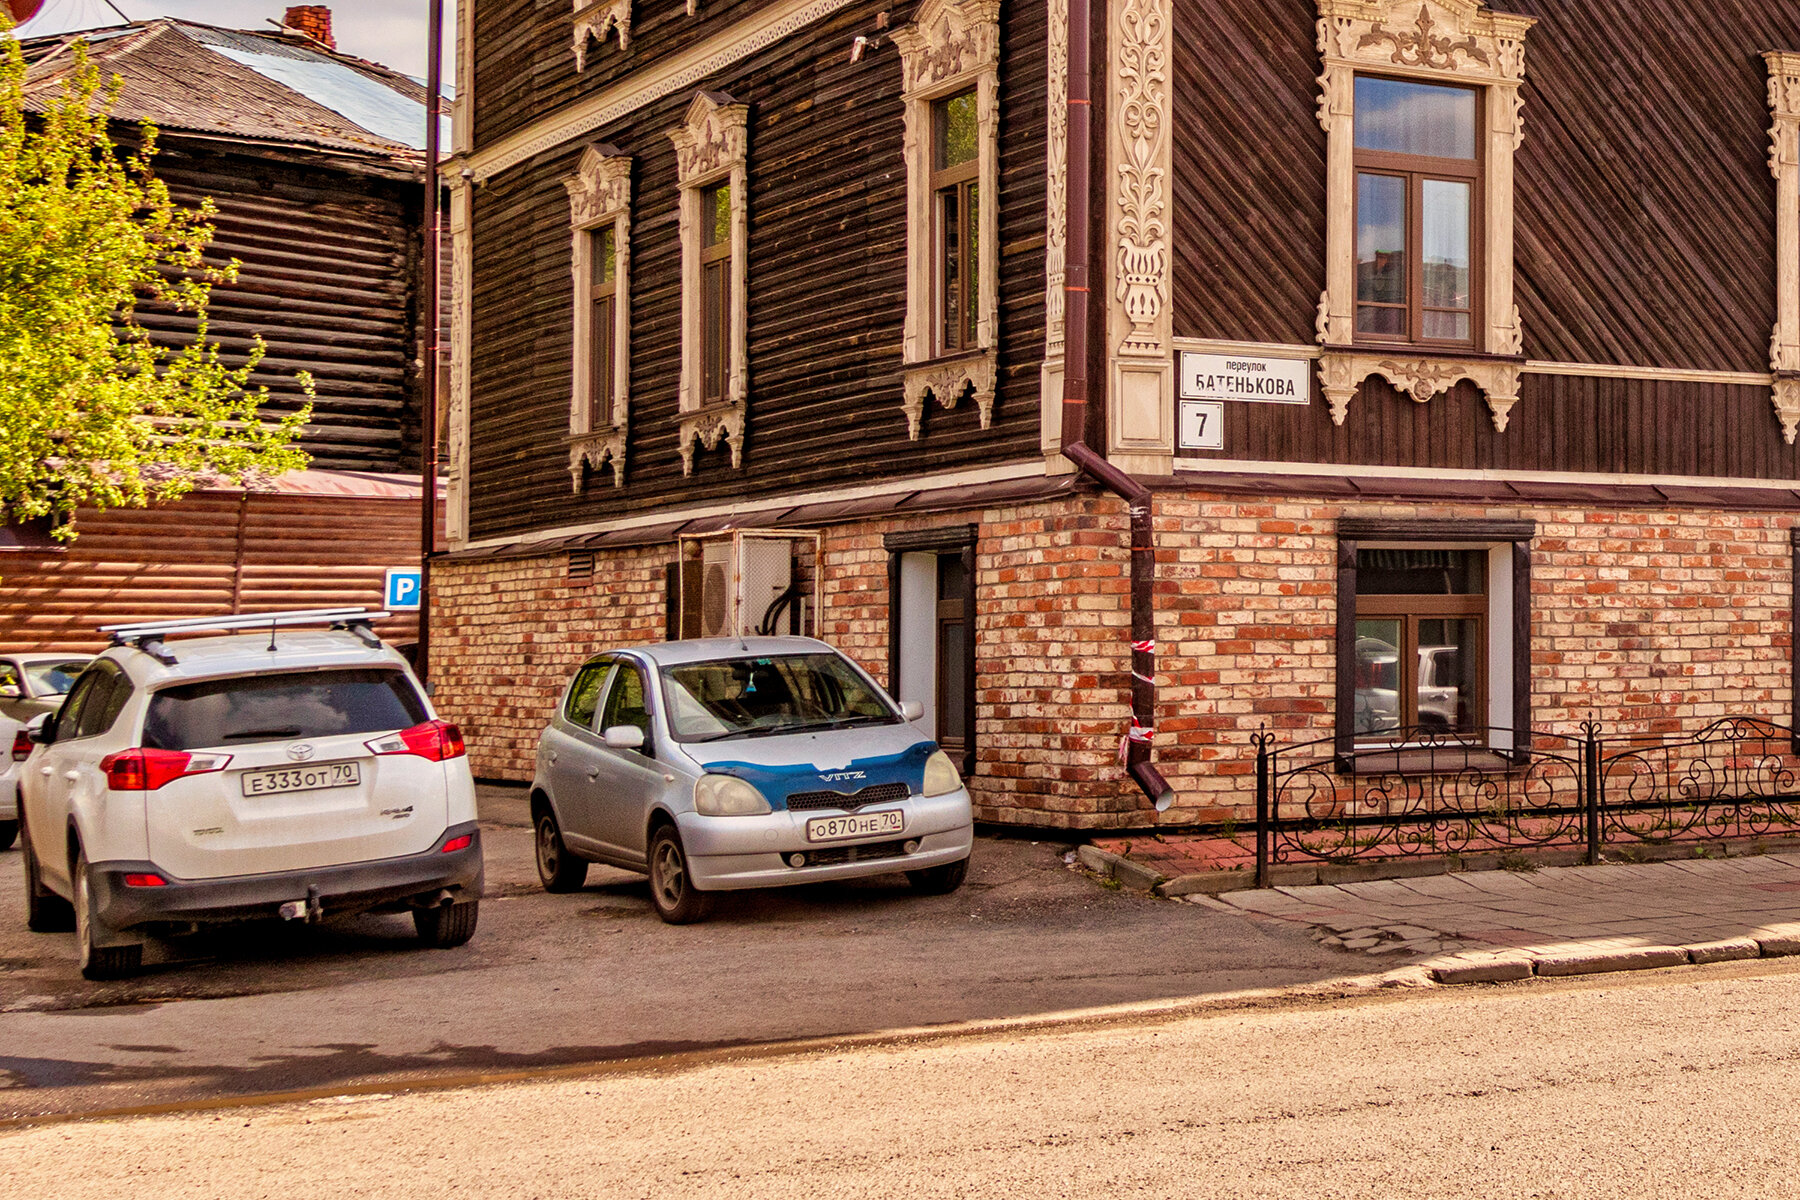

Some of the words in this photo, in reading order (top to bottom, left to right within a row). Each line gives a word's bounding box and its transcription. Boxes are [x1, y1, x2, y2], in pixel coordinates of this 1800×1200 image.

[1226, 361, 1266, 373] переулок
[1196, 413, 1208, 437] 7
[397, 578, 415, 601] P
[333, 765, 352, 779] 70
[818, 771, 867, 782] VITZ
[882, 813, 897, 826] 70
